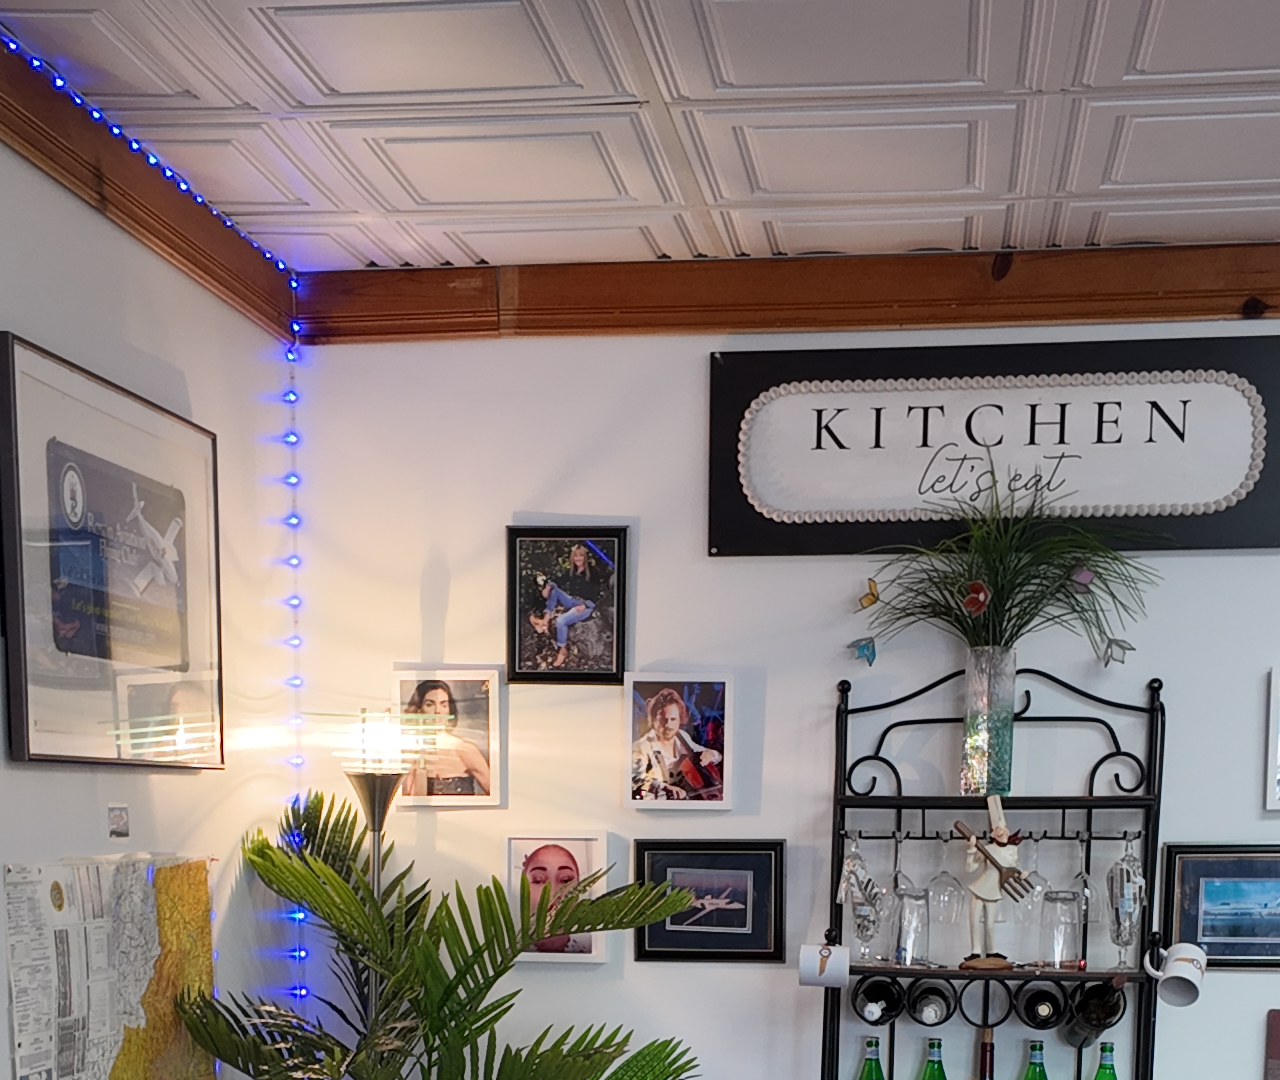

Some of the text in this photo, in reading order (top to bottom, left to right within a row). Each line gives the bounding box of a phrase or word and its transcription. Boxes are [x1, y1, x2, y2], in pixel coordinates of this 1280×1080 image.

[810, 399, 1193, 451] KITCHEN
[918, 442, 1082, 502] let's eat
